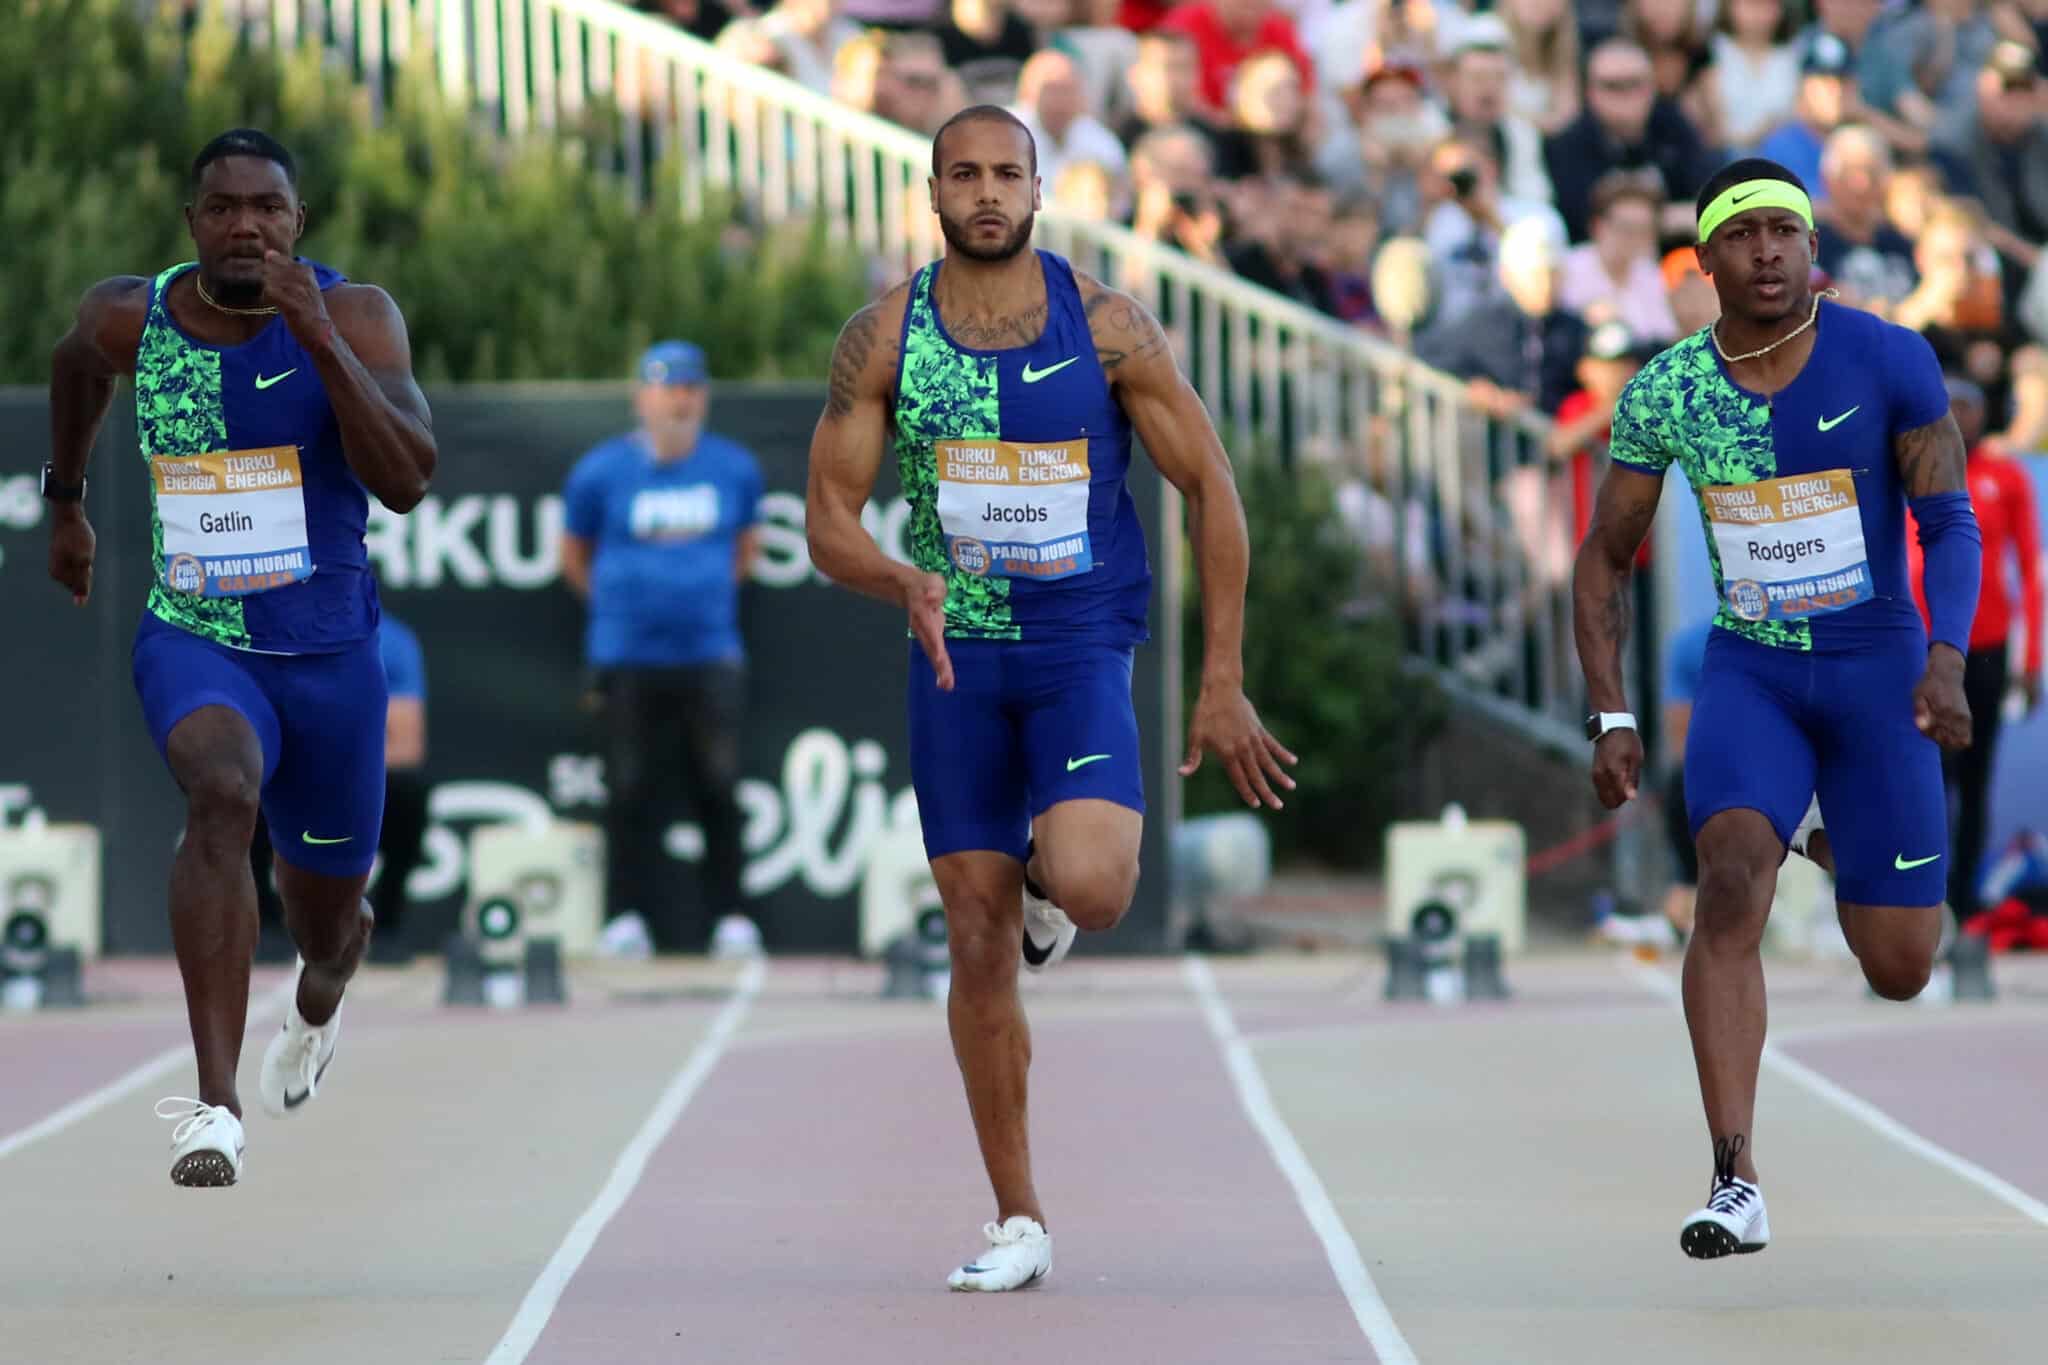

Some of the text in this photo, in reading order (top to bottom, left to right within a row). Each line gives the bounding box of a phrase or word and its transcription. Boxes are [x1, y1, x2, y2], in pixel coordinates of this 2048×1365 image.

[224, 455, 275, 473] TURKU
[945, 448, 995, 463] TURKU
[1019, 449, 1067, 465] TURKU
[157, 461, 200, 475] TURKU
[947, 464, 1009, 481] ENERGIA
[1019, 464, 1083, 481] ENERGIA
[164, 475, 216, 490] ENERGIA
[225, 470, 293, 489] ENERGIA
[1708, 490, 1756, 505] TURKU
[1779, 480, 1830, 499] TURKU
[982, 502, 1048, 522] Jacobs
[1715, 505, 1775, 521] ENERGIA
[1782, 492, 1848, 518] ENERGIA
[200, 511, 252, 533] Gatlin
[992, 538, 1083, 562] PAAVO NURMI
[1748, 538, 1825, 563] Rodgers
[205, 552, 303, 577] PAAVO NURMI
[959, 554, 984, 568] 2019
[176, 576, 200, 589] 2019
[1768, 568, 1864, 602] PAAVO NURMI
[1738, 600, 1763, 613] 2019
